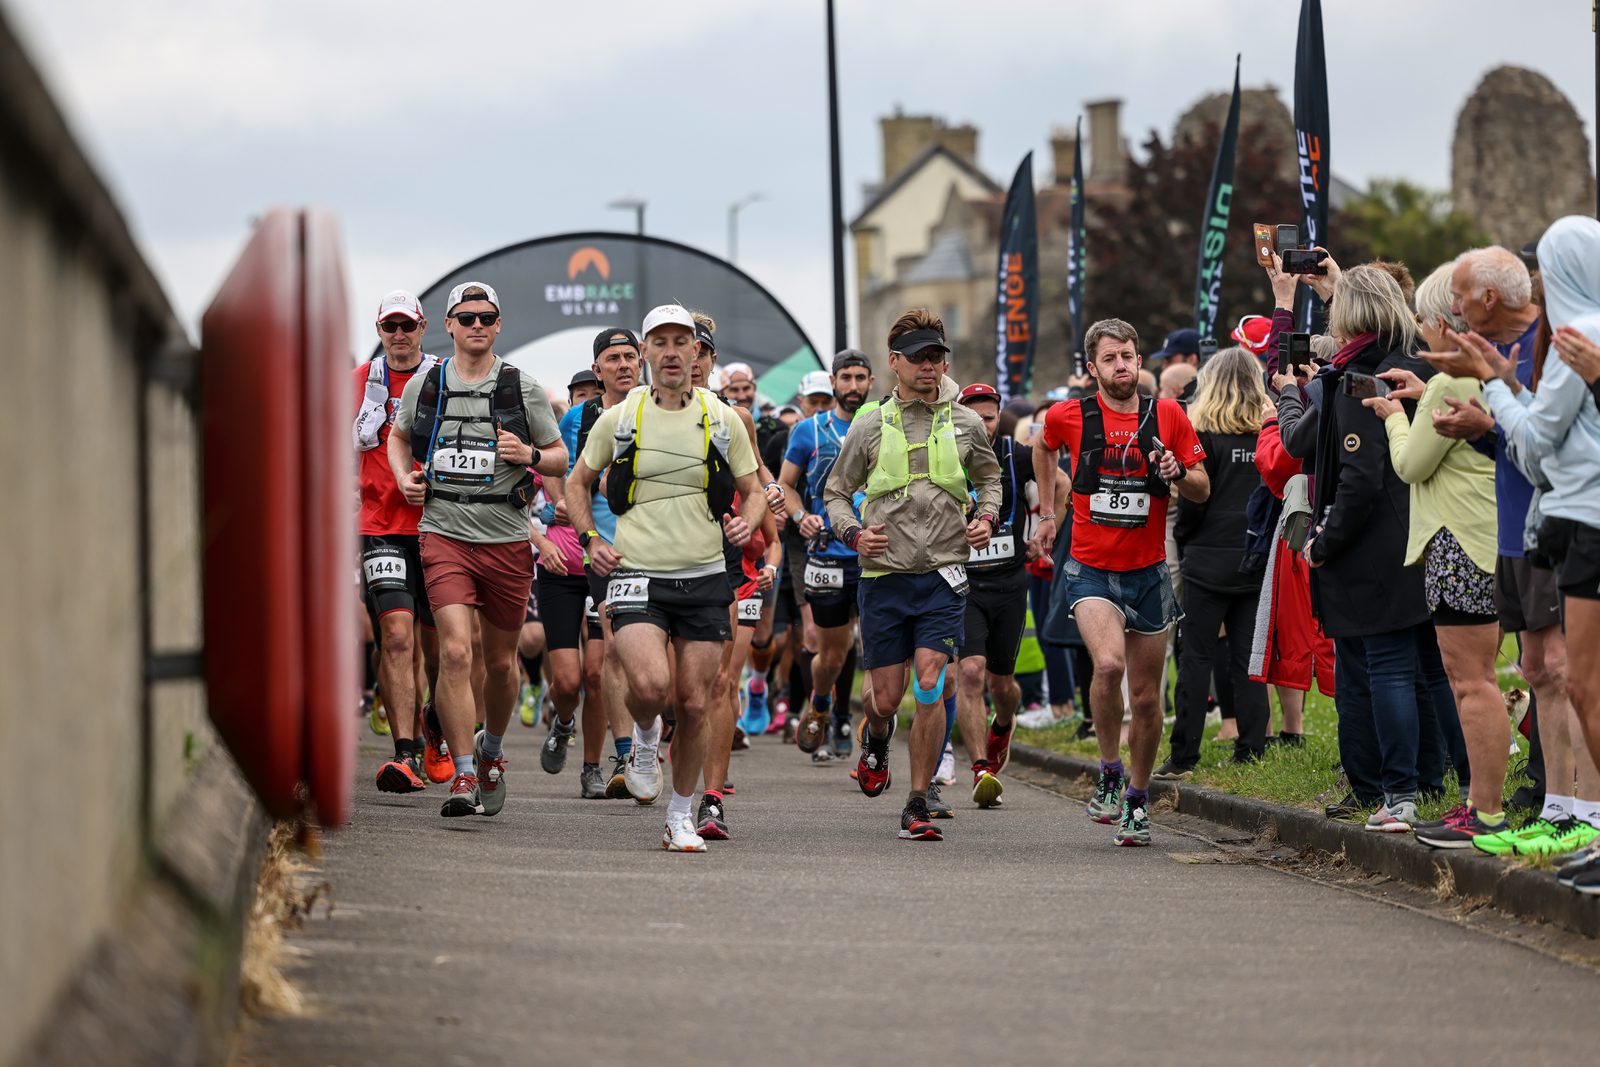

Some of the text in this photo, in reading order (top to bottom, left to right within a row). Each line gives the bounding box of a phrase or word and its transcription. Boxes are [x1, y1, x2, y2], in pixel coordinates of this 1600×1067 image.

[544, 284, 634, 302] EMBRACE
[561, 301, 619, 315] ULTRA
[449, 454, 476, 470] 121
[1109, 495, 1130, 510] 89
[369, 561, 394, 577] 144
[810, 571, 830, 585] 168
[610, 583, 632, 599] 127
[745, 603, 757, 616] 65
